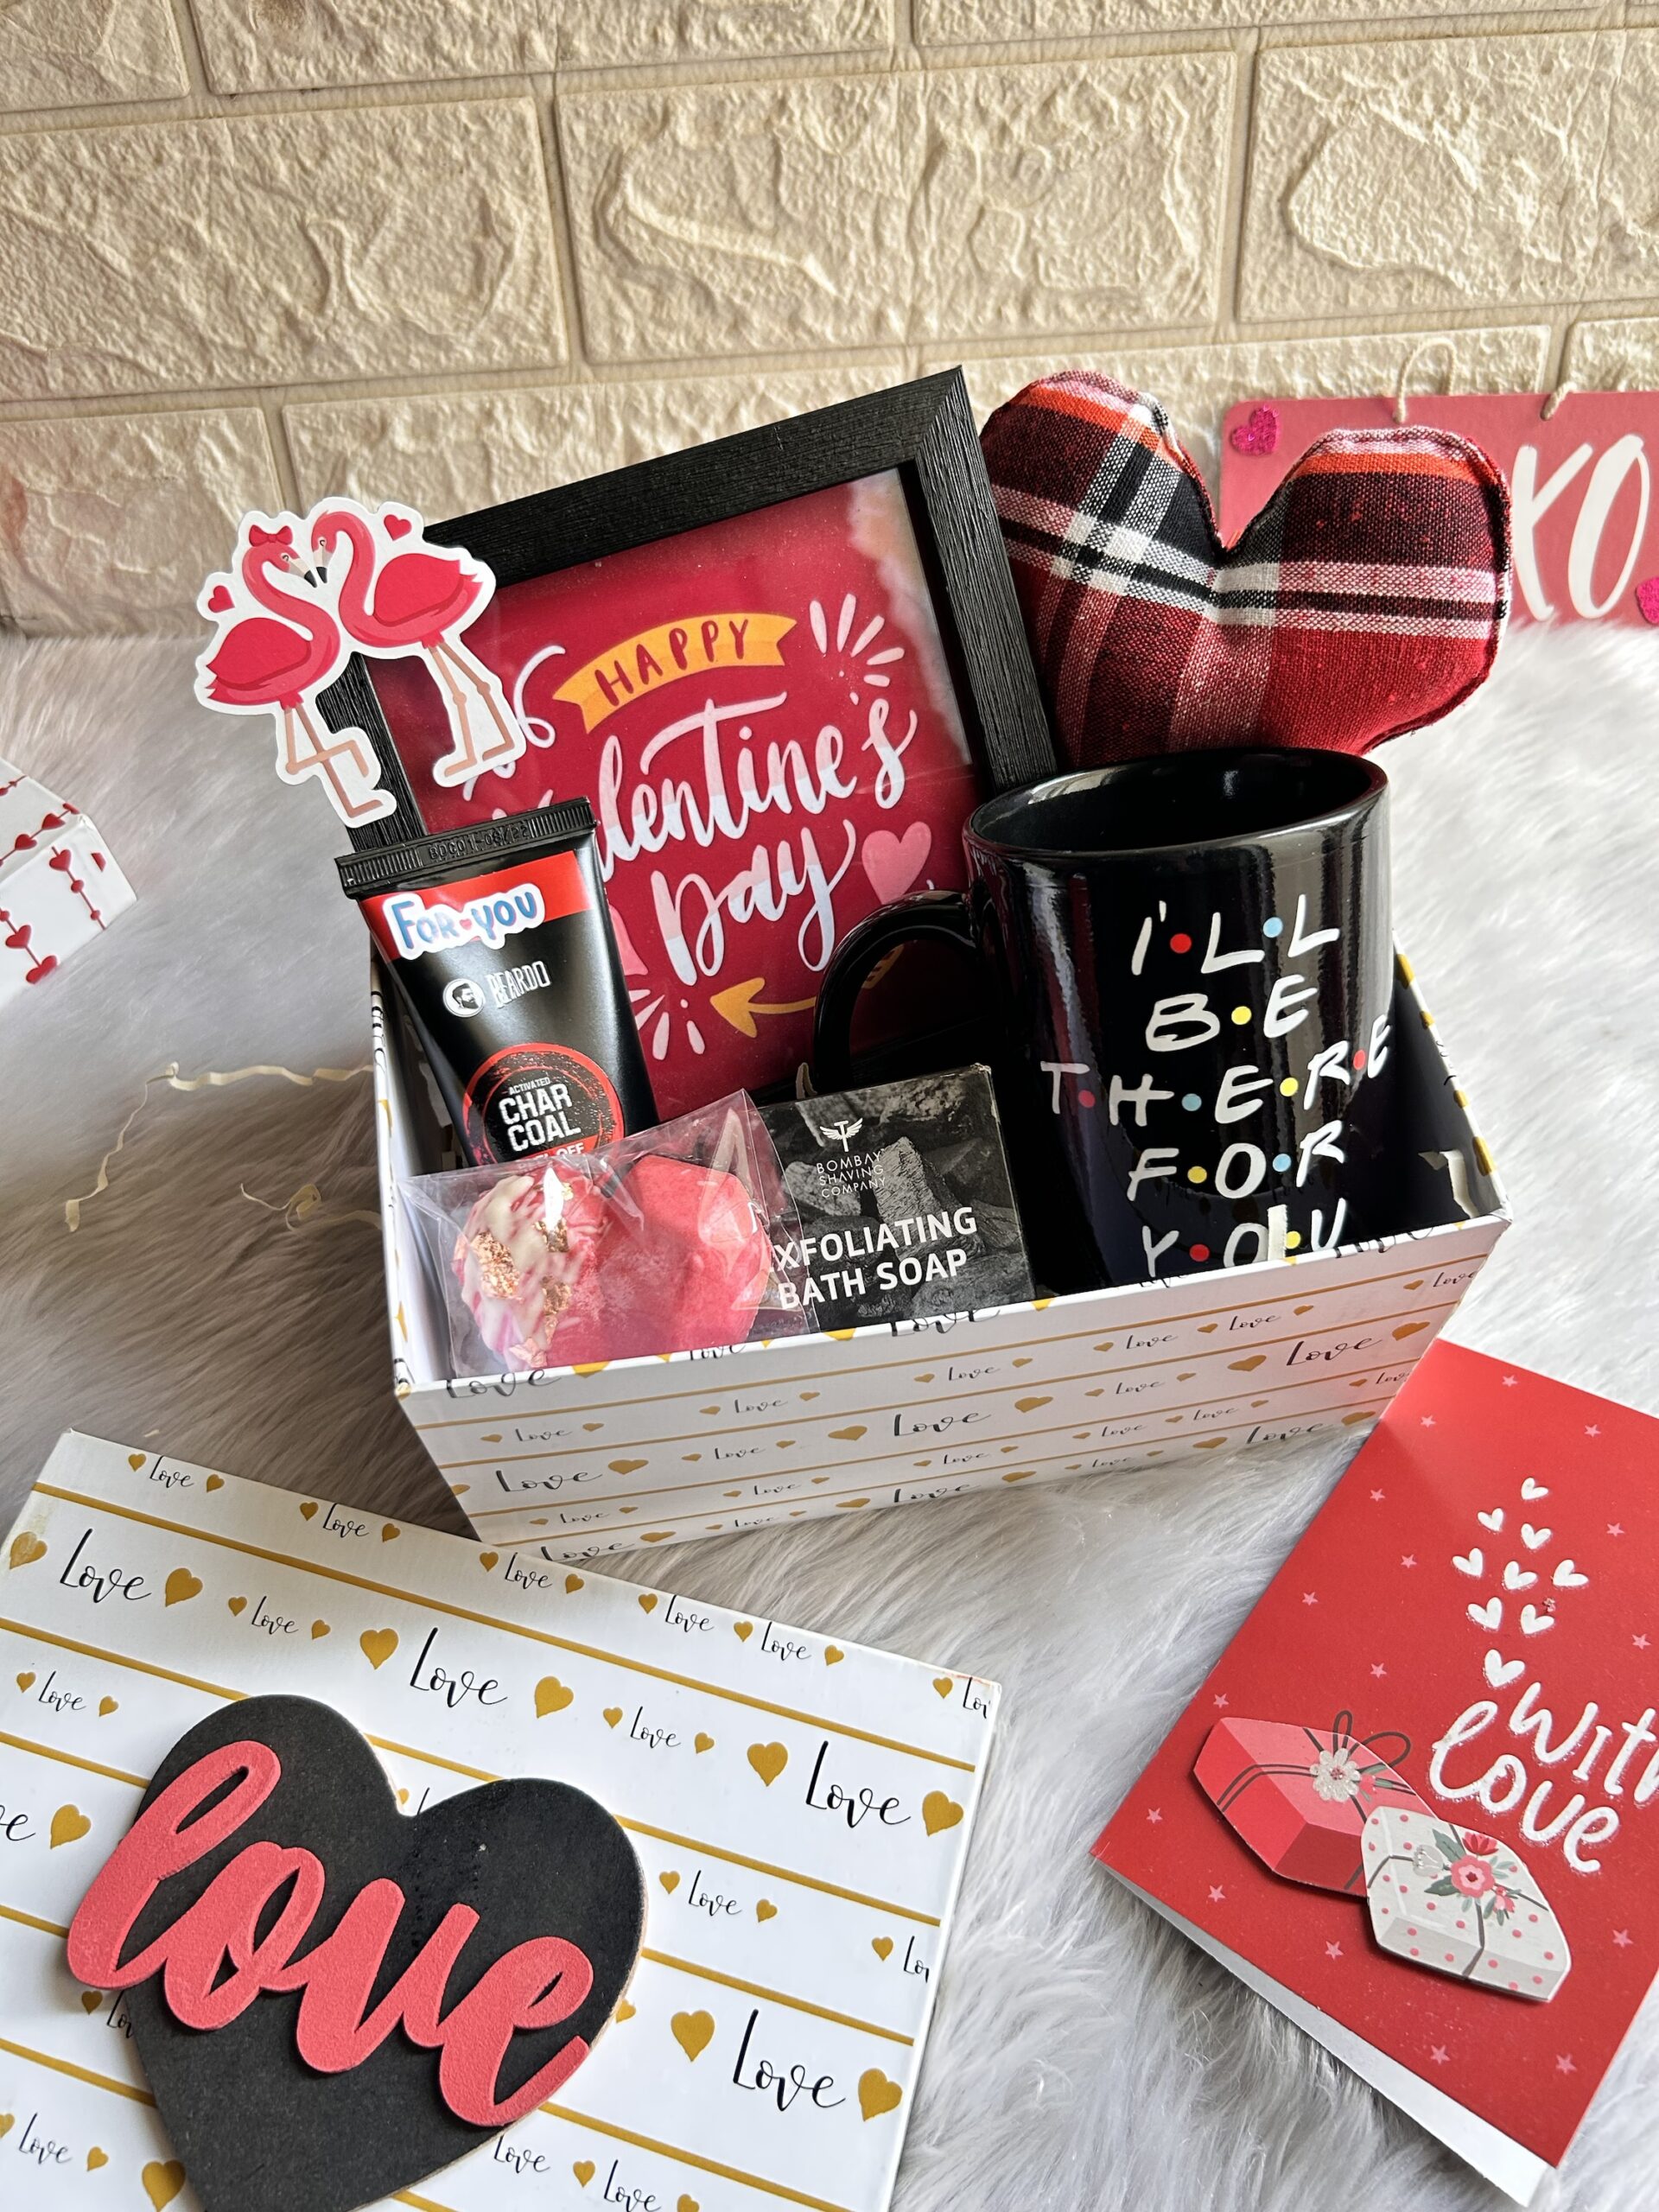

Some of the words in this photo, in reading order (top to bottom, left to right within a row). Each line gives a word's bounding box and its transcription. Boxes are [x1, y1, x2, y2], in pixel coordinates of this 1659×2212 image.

[594, 619, 749, 707] HAPPY
[518, 657, 918, 882] lentine's
[651, 819, 856, 986] Day
[485, 960, 551, 1009] BEARDO
[1145, 975, 1319, 1052] BE
[499, 1083, 573, 1125] CHAR
[509, 1077, 551, 1096] ACTIVATED
[1040, 1014, 1391, 1127] THERE
[507, 1110, 582, 1152] COAL
[816, 1149, 883, 1174] BOMBAY
[1127, 1120, 1345, 1202] FOR
[819, 1164, 885, 1186] SHAVING
[821, 1177, 887, 1198] COMPANY
[771, 1207, 977, 1272] XFOLIATING
[1141, 1198, 1348, 1278] YOU
[778, 1269, 866, 1310] BATH
[876, 1248, 968, 1291] SOAP
[495, 1470, 602, 1493] Love
[715, 1445, 766, 1460] Love
[893, 1409, 991, 1437] Love
[1116, 1380, 1165, 1395] Love
[1286, 1337, 1383, 1367] Love
[514, 1428, 572, 1442] Love
[734, 1397, 787, 1414] Love
[948, 1366, 1000, 1382] Love
[1126, 1333, 1178, 1350] Love
[1229, 1313, 1281, 1332] Love
[149, 1455, 194, 1488] Love
[322, 1503, 370, 1538] Love
[505, 1552, 553, 1590] Love
[664, 1594, 715, 1633] Love
[760, 1621, 811, 1662] Love
[60, 1528, 152, 1604] Love
[251, 1595, 299, 1636] Love
[410, 1627, 508, 1708] Love
[629, 1706, 682, 1750] Love
[805, 1740, 912, 1829] Love
[38, 1670, 86, 1713] Love
[688, 1869, 742, 1917] Love
[732, 2007, 847, 2113] Love
[18, 2112, 73, 2165] Love
[493, 2134, 551, 2175] Love
[603, 2158, 662, 2212] Love
